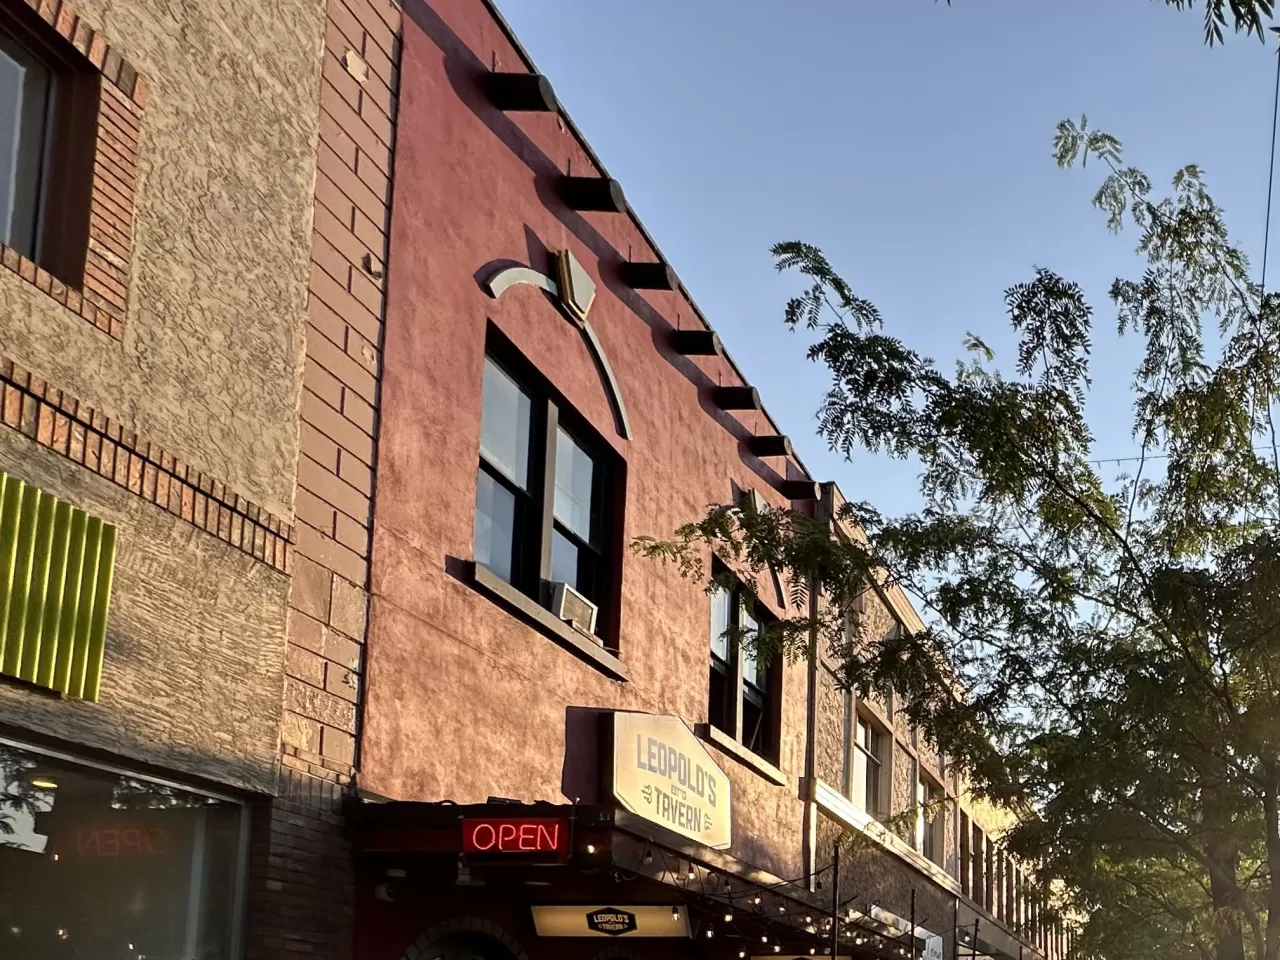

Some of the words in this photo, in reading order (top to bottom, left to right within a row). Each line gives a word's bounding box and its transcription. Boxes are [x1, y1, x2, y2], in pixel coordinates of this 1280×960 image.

[637, 734, 717, 808] LEOPOLD'S
[654, 786, 701, 833] TAVERN
[473, 824, 559, 850] OPEN
[593, 914, 629, 923] LEOPOLD'S
